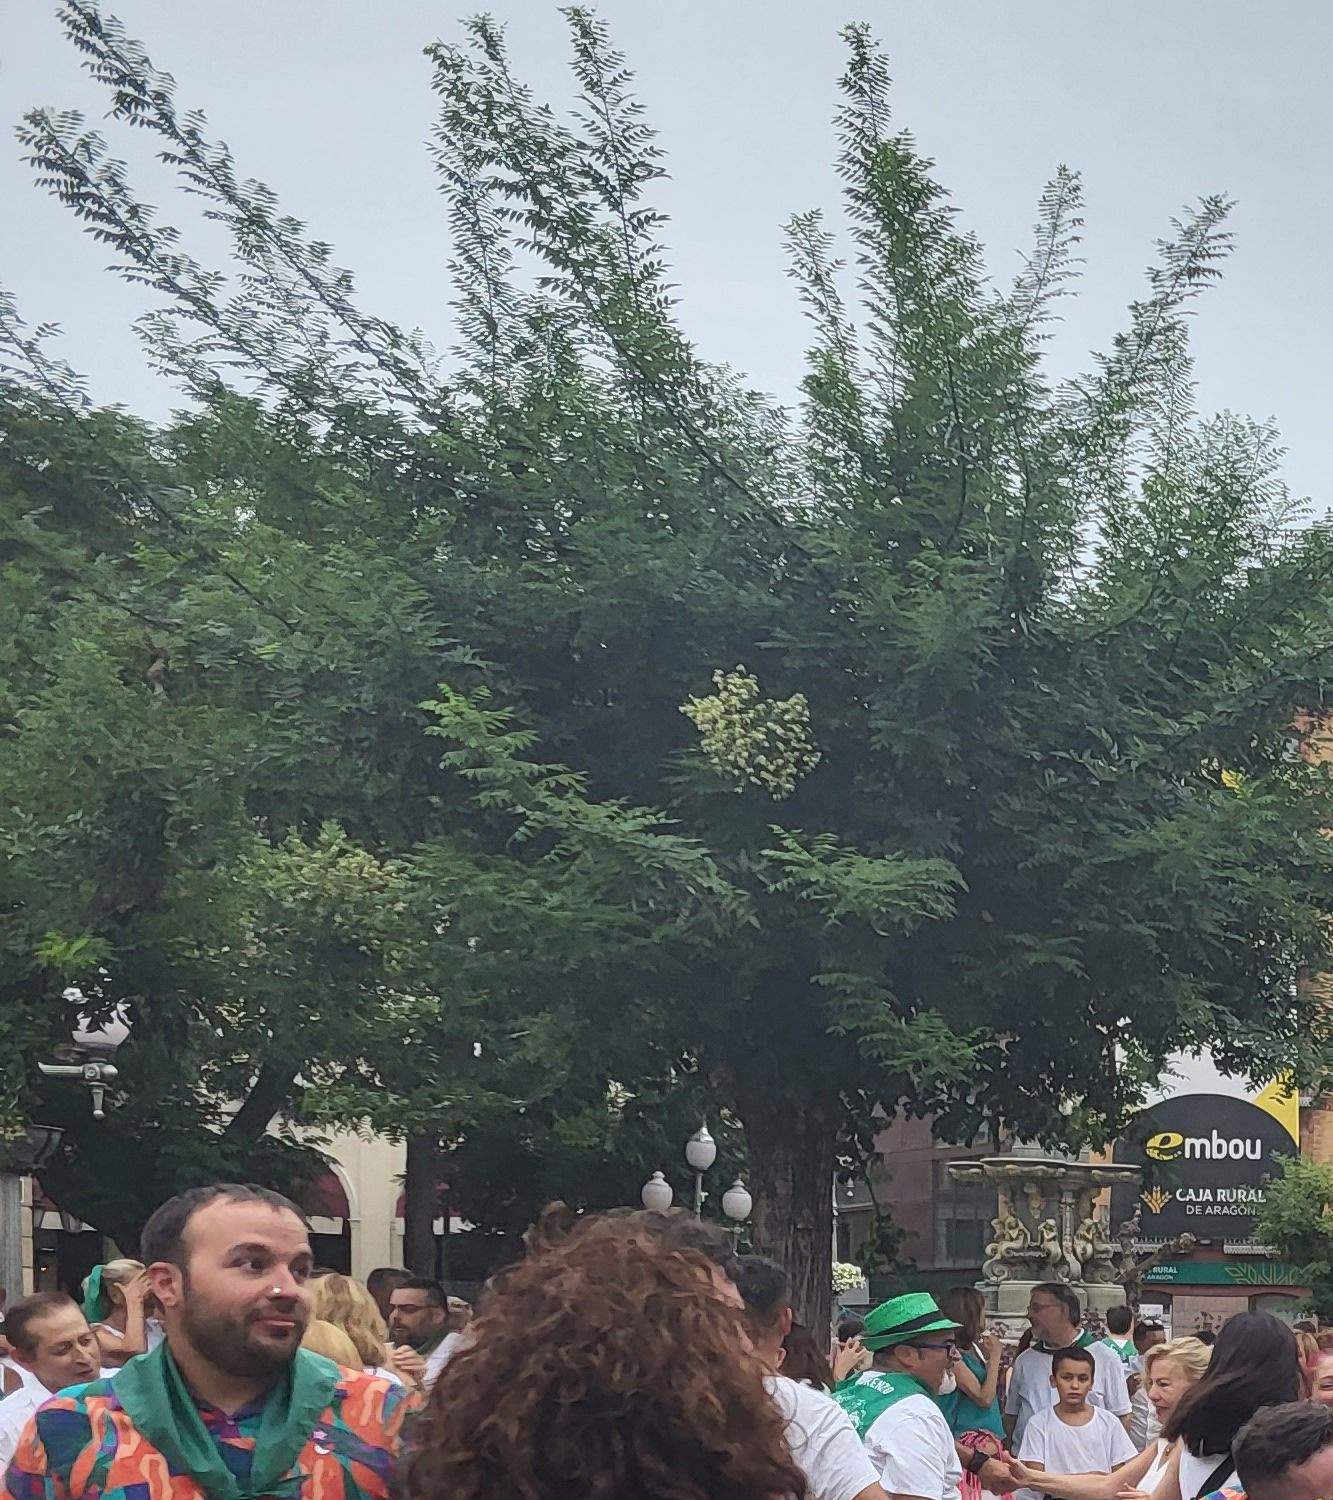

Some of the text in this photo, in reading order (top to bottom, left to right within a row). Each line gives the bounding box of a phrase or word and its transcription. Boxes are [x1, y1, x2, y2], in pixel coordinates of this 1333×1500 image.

[1145, 1130, 1262, 1161] embou
[1175, 1188, 1267, 1204] CAJA RURAL
[1186, 1205, 1204, 1216] DE
